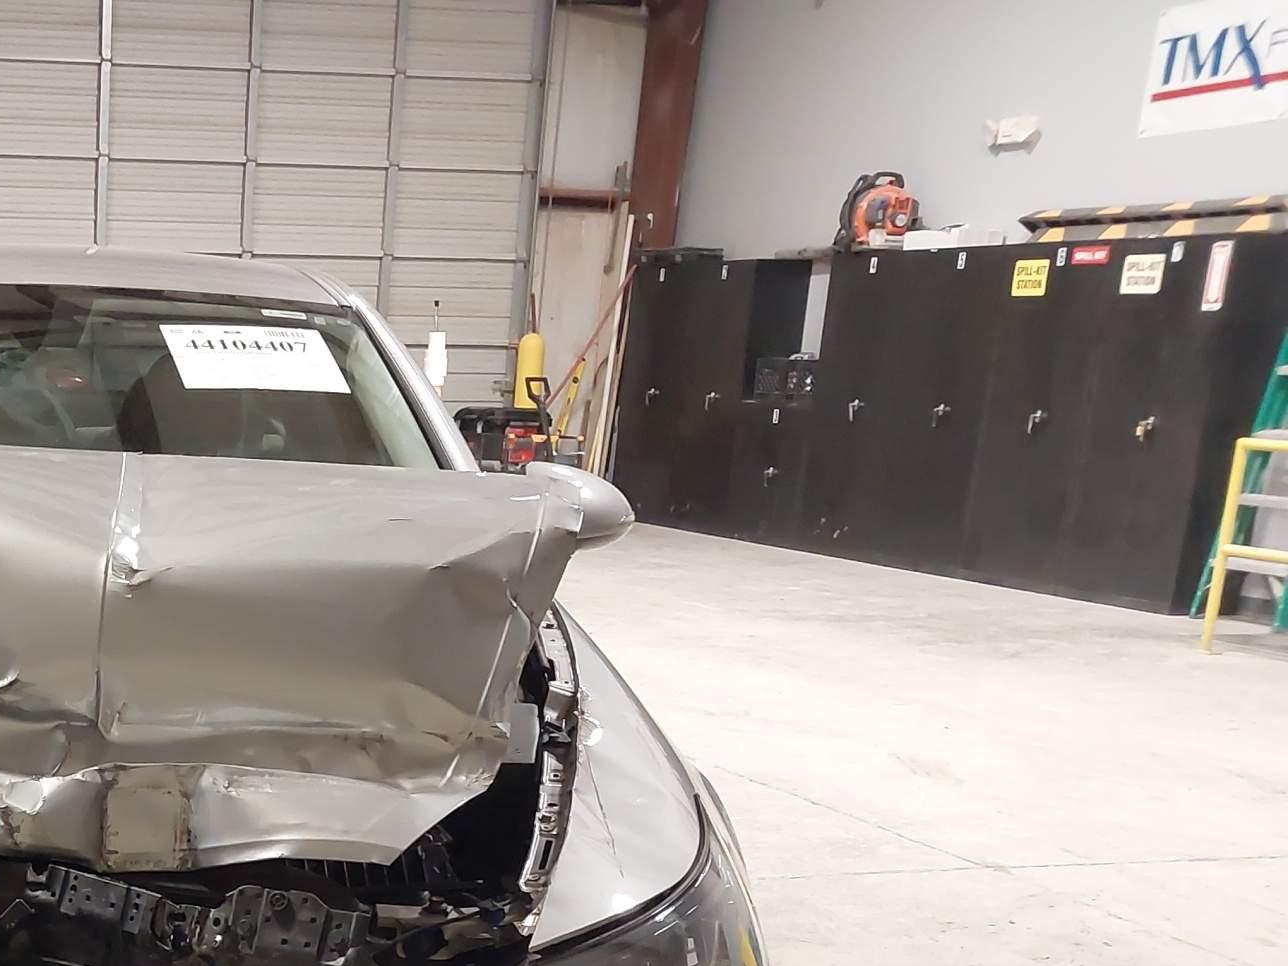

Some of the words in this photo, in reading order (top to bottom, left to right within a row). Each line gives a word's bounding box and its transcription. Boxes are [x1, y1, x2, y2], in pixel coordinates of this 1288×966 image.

[1159, 17, 1268, 90] TMX
[1016, 279, 1043, 289] STATION
[186, 338, 307, 353] 44104407
